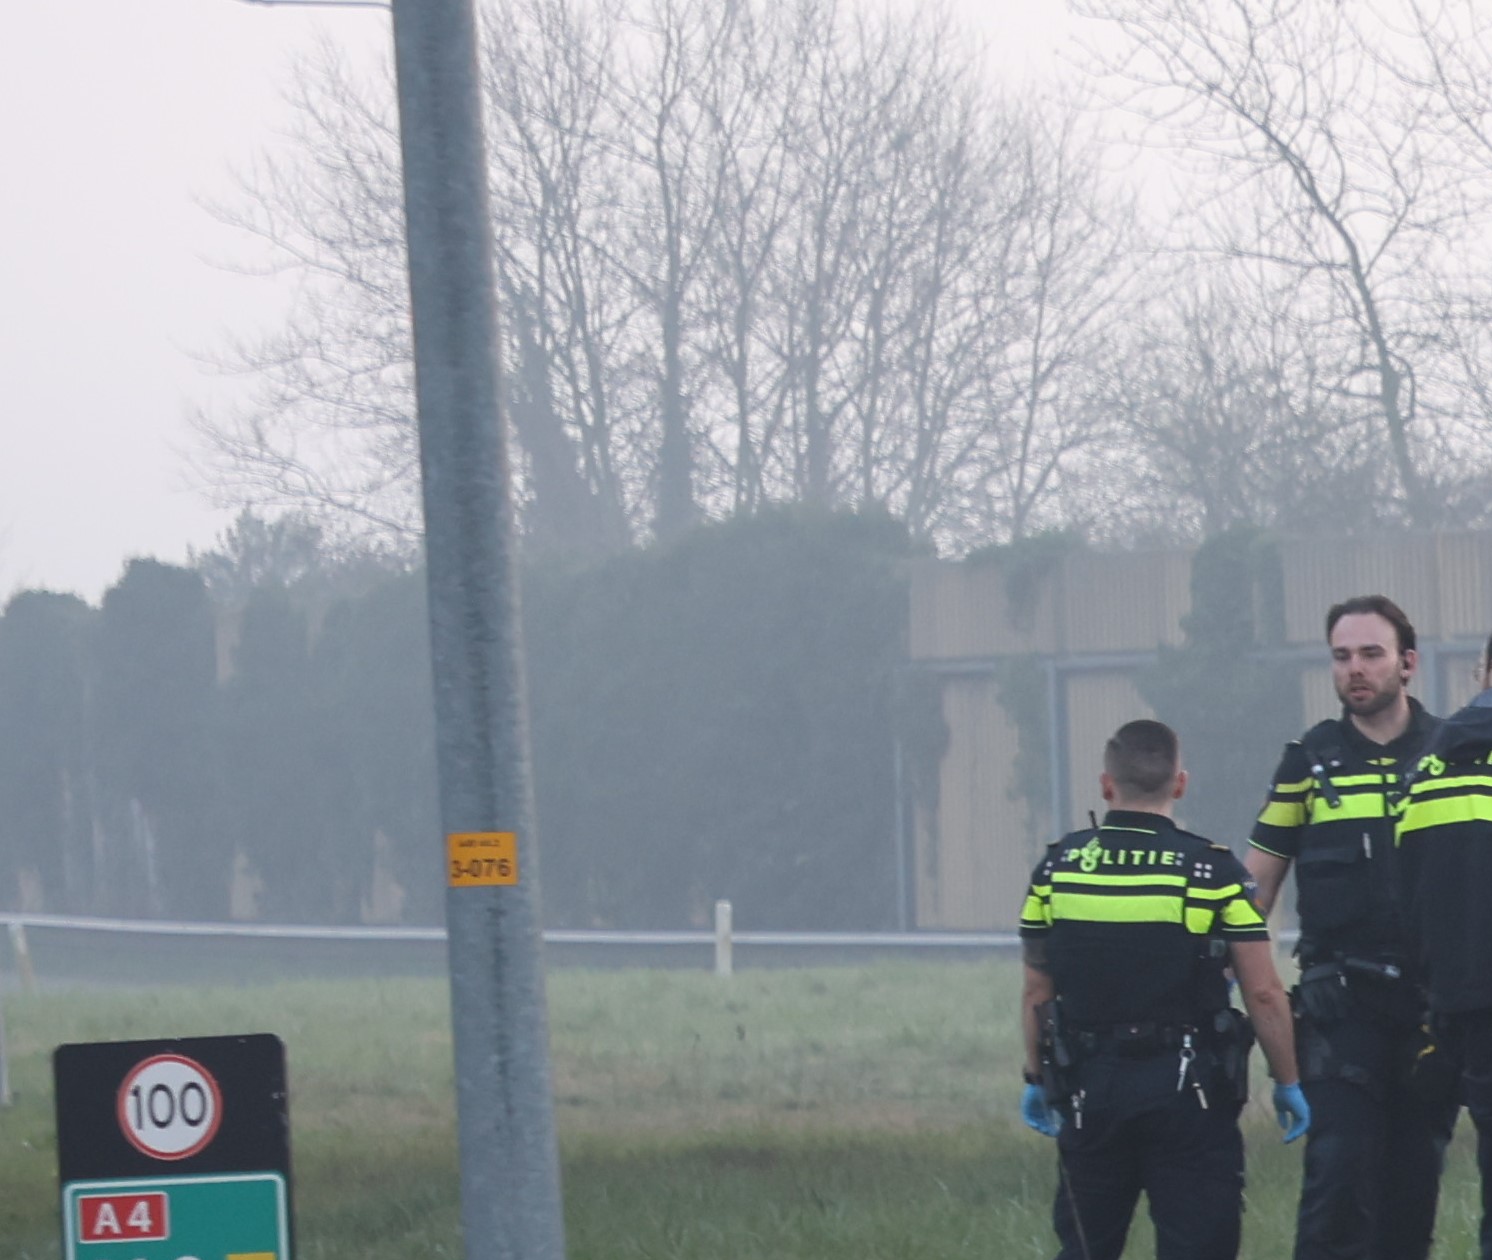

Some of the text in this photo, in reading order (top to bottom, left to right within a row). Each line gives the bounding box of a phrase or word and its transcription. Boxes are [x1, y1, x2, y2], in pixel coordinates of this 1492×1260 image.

[1067, 841, 1175, 871] POLITIE
[130, 1081, 207, 1131] 100
[92, 1201, 153, 1236] A4
